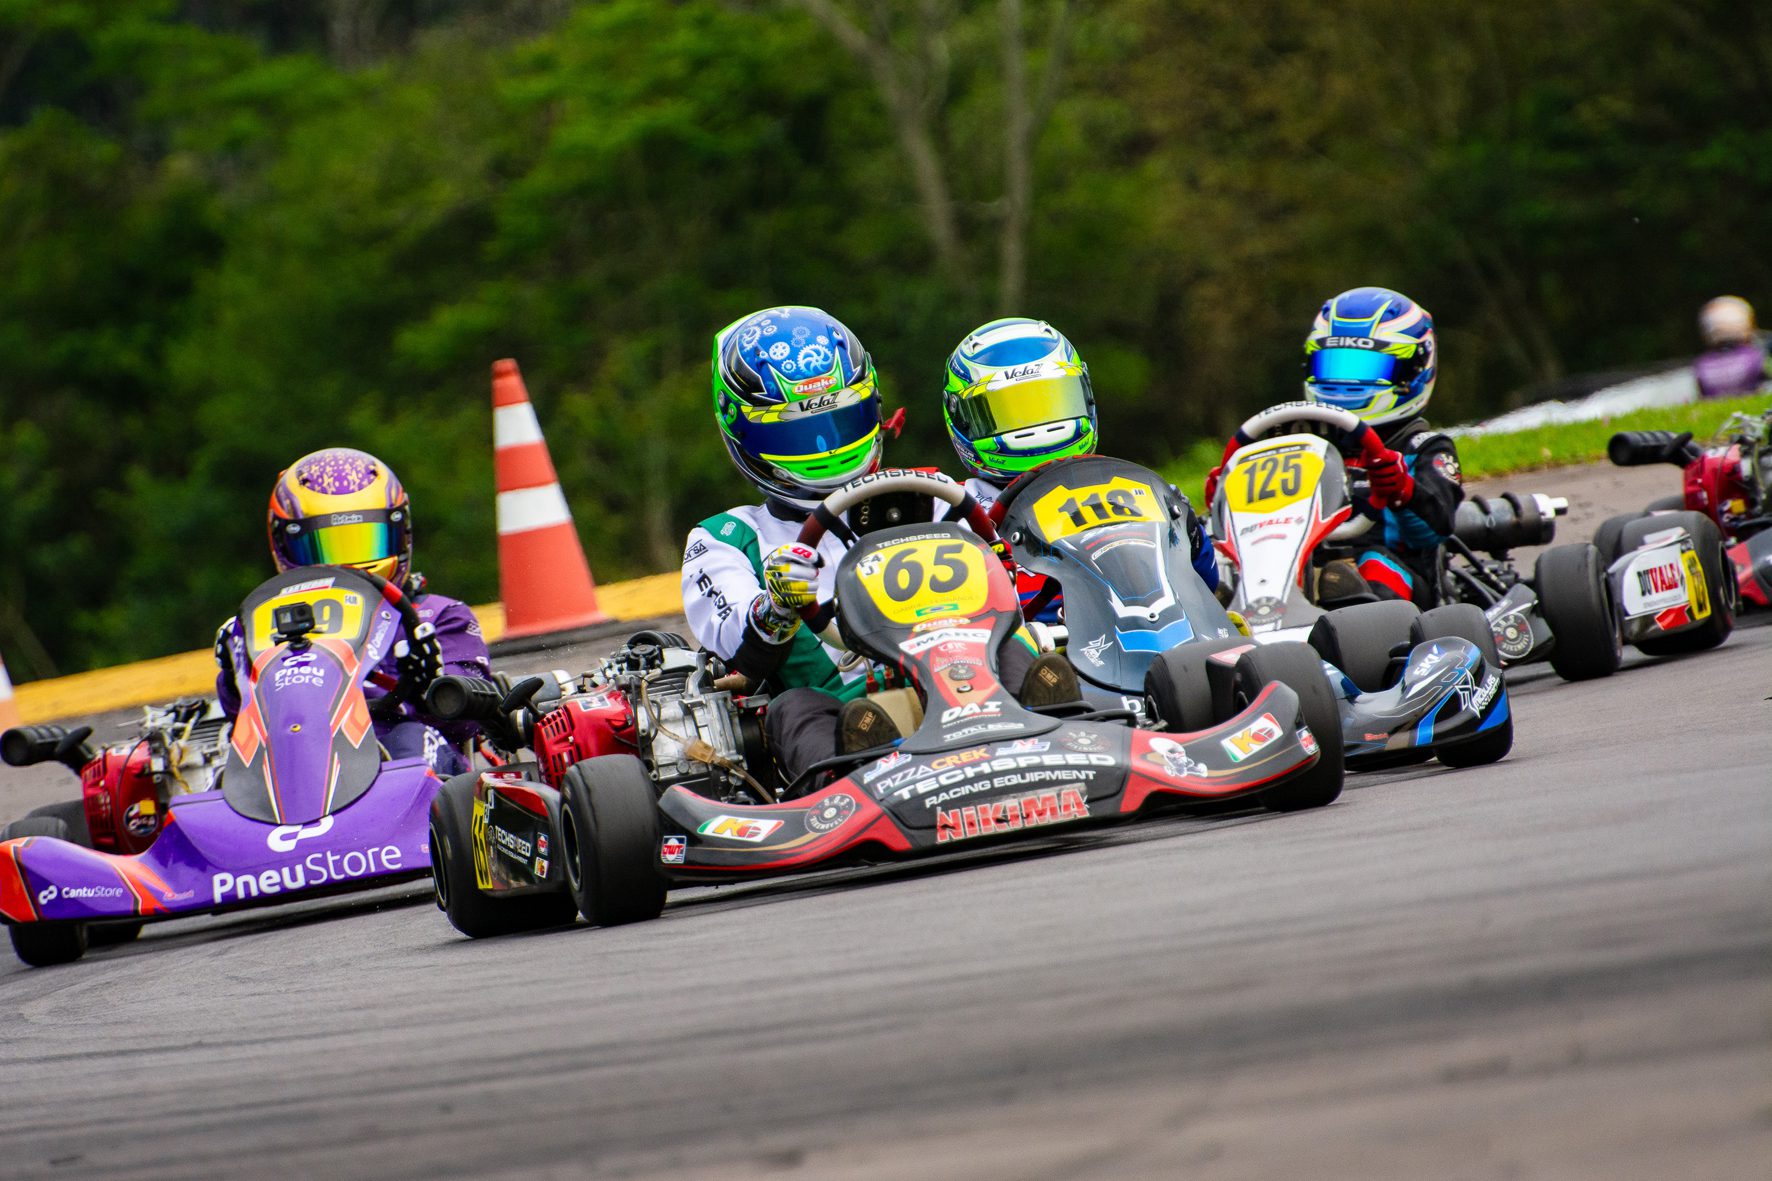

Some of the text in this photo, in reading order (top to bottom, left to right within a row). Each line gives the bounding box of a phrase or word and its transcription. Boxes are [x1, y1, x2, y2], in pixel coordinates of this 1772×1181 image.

[1325, 336, 1375, 349] EIKO
[841, 469, 949, 493] TECHSPEED
[1243, 453, 1303, 505] 125
[1058, 489, 1144, 527] 118
[876, 533, 951, 550] TECHSPEED
[883, 543, 969, 602] 65
[275, 666, 325, 681] Pneu
[275, 675, 324, 692] Store
[1040, 667, 1059, 684] OMP
[941, 701, 1002, 723] DAI
[893, 754, 1116, 800] TECHSPEED
[925, 770, 1096, 808] RACING EQUIPMENT
[936, 788, 1090, 844] NIKIMA
[213, 844, 402, 904] PneuStore
[62, 886, 124, 899] CantuStore
